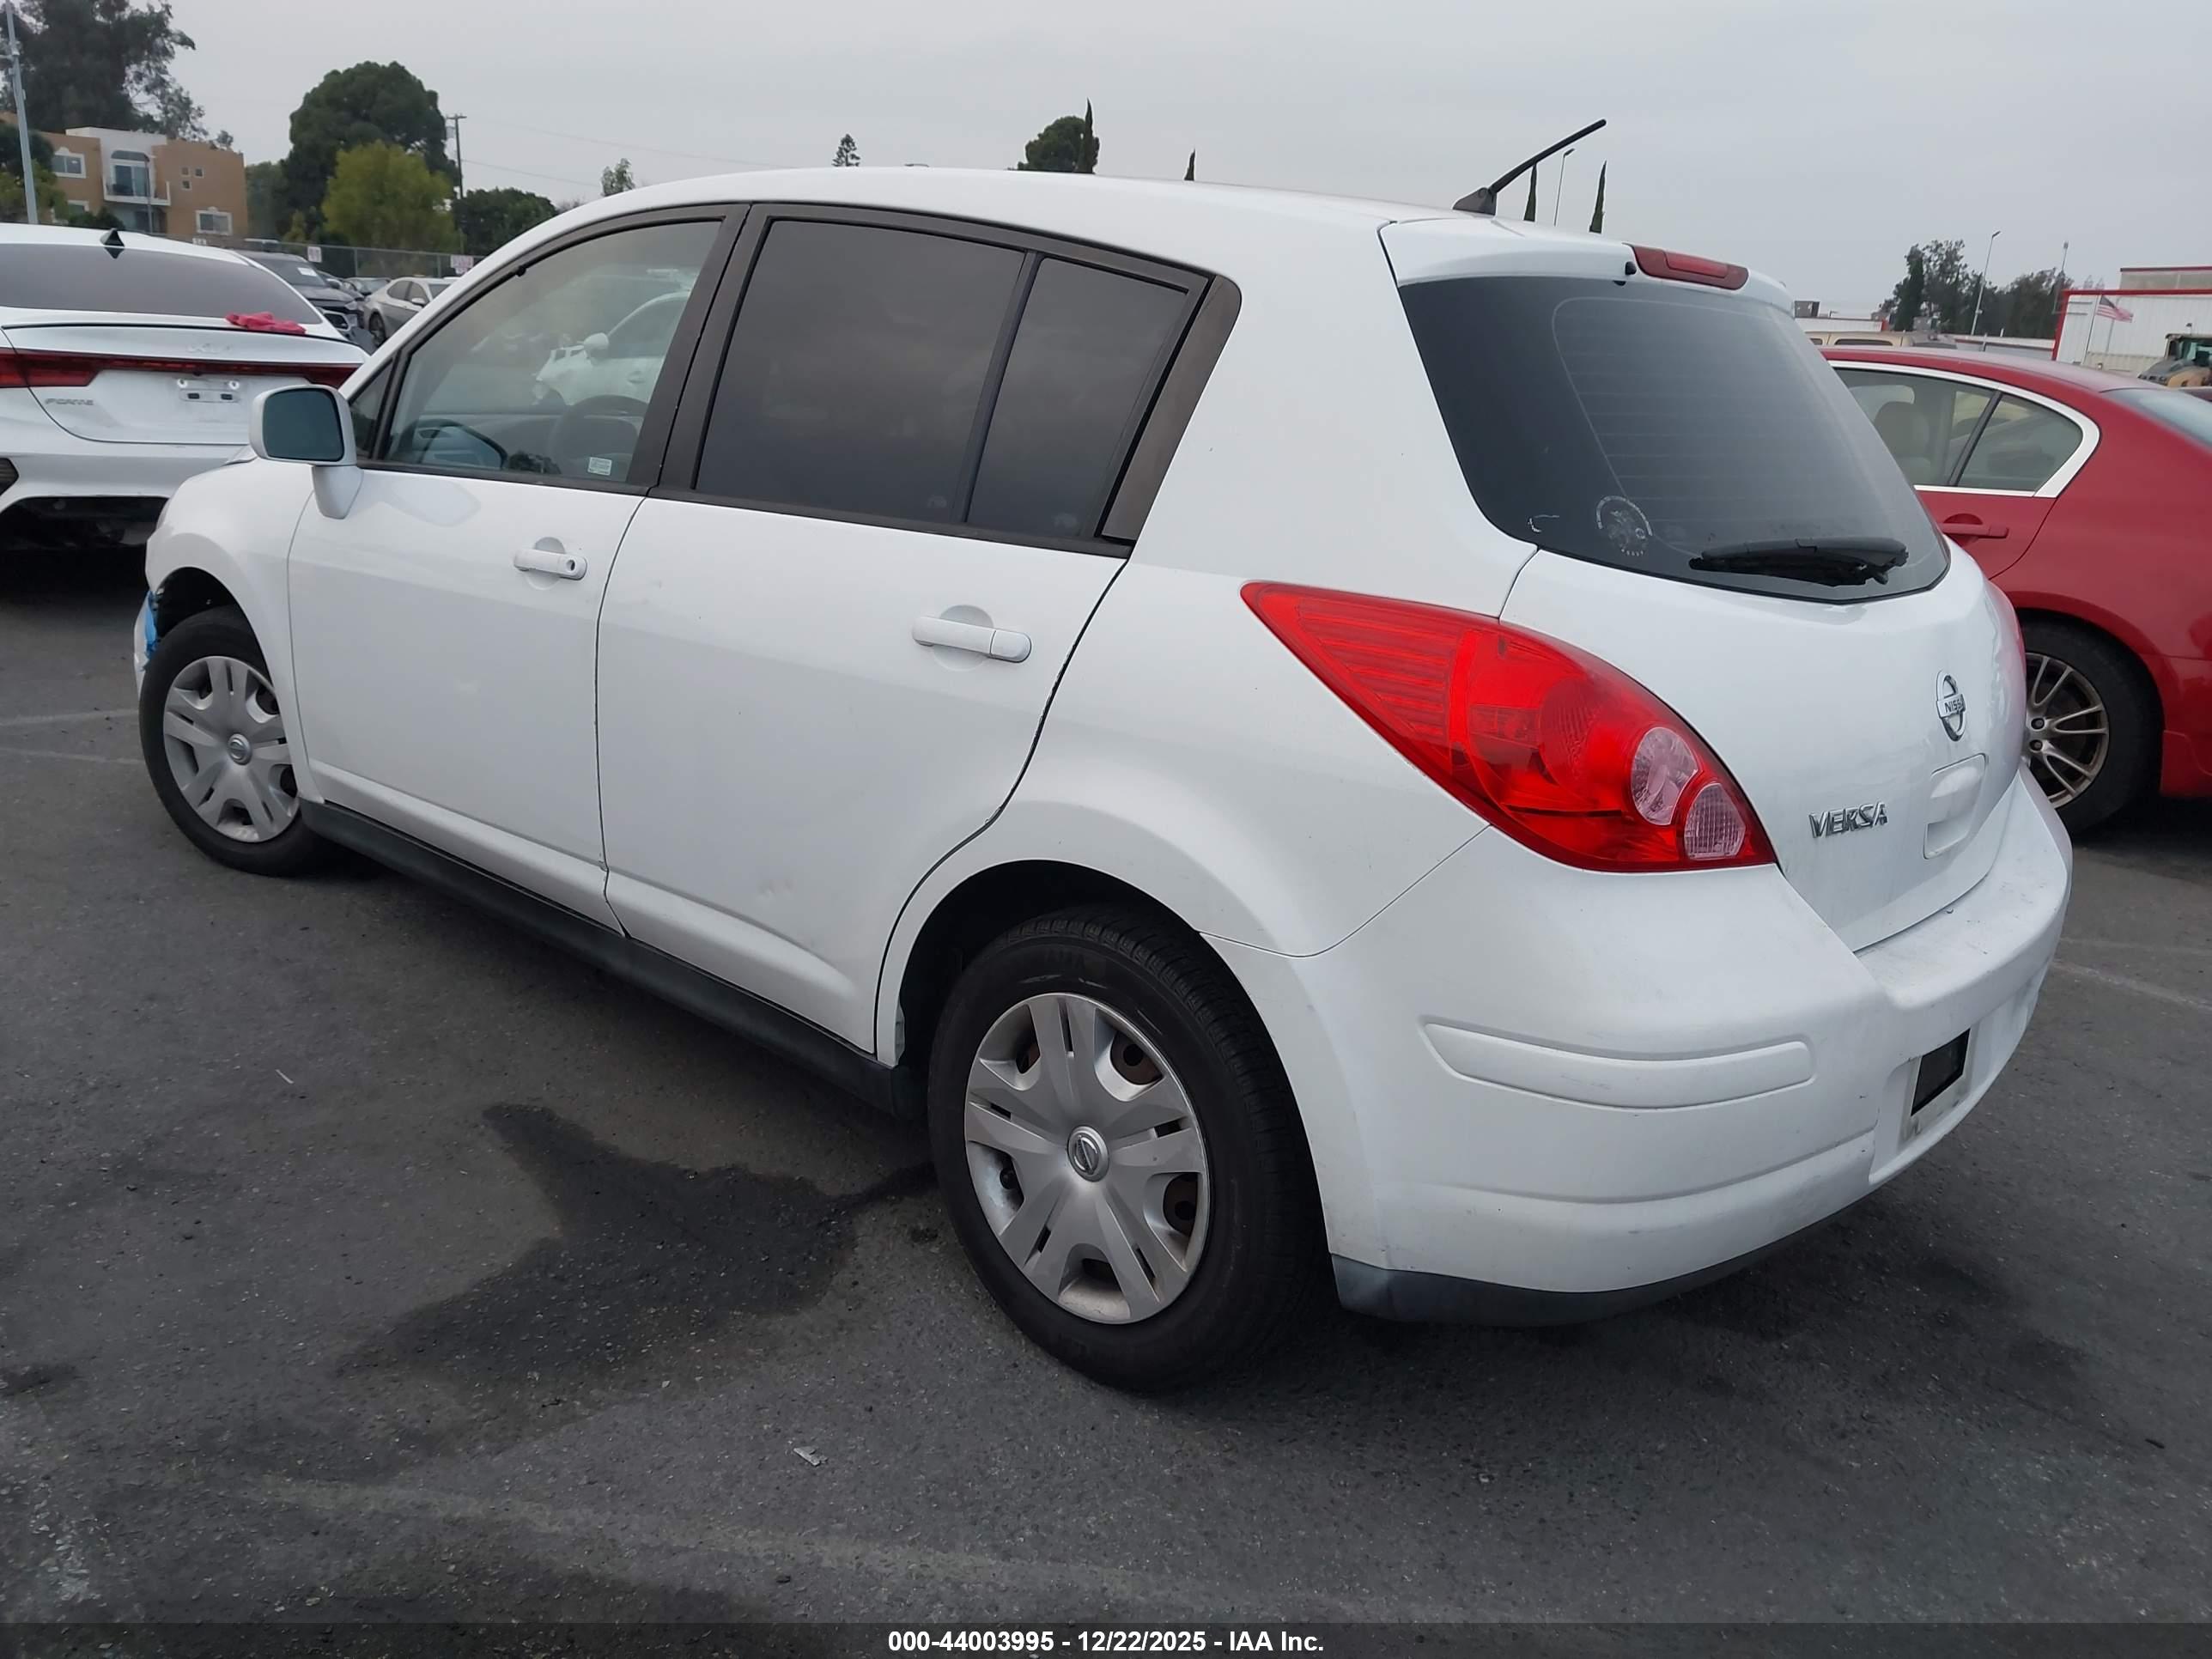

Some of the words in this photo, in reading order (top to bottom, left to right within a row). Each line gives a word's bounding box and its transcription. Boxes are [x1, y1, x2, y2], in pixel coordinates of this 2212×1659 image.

[45, 398, 94, 406] FORTE
[1943, 697, 1965, 714] NISS
[1808, 801, 1888, 838] VERSA
